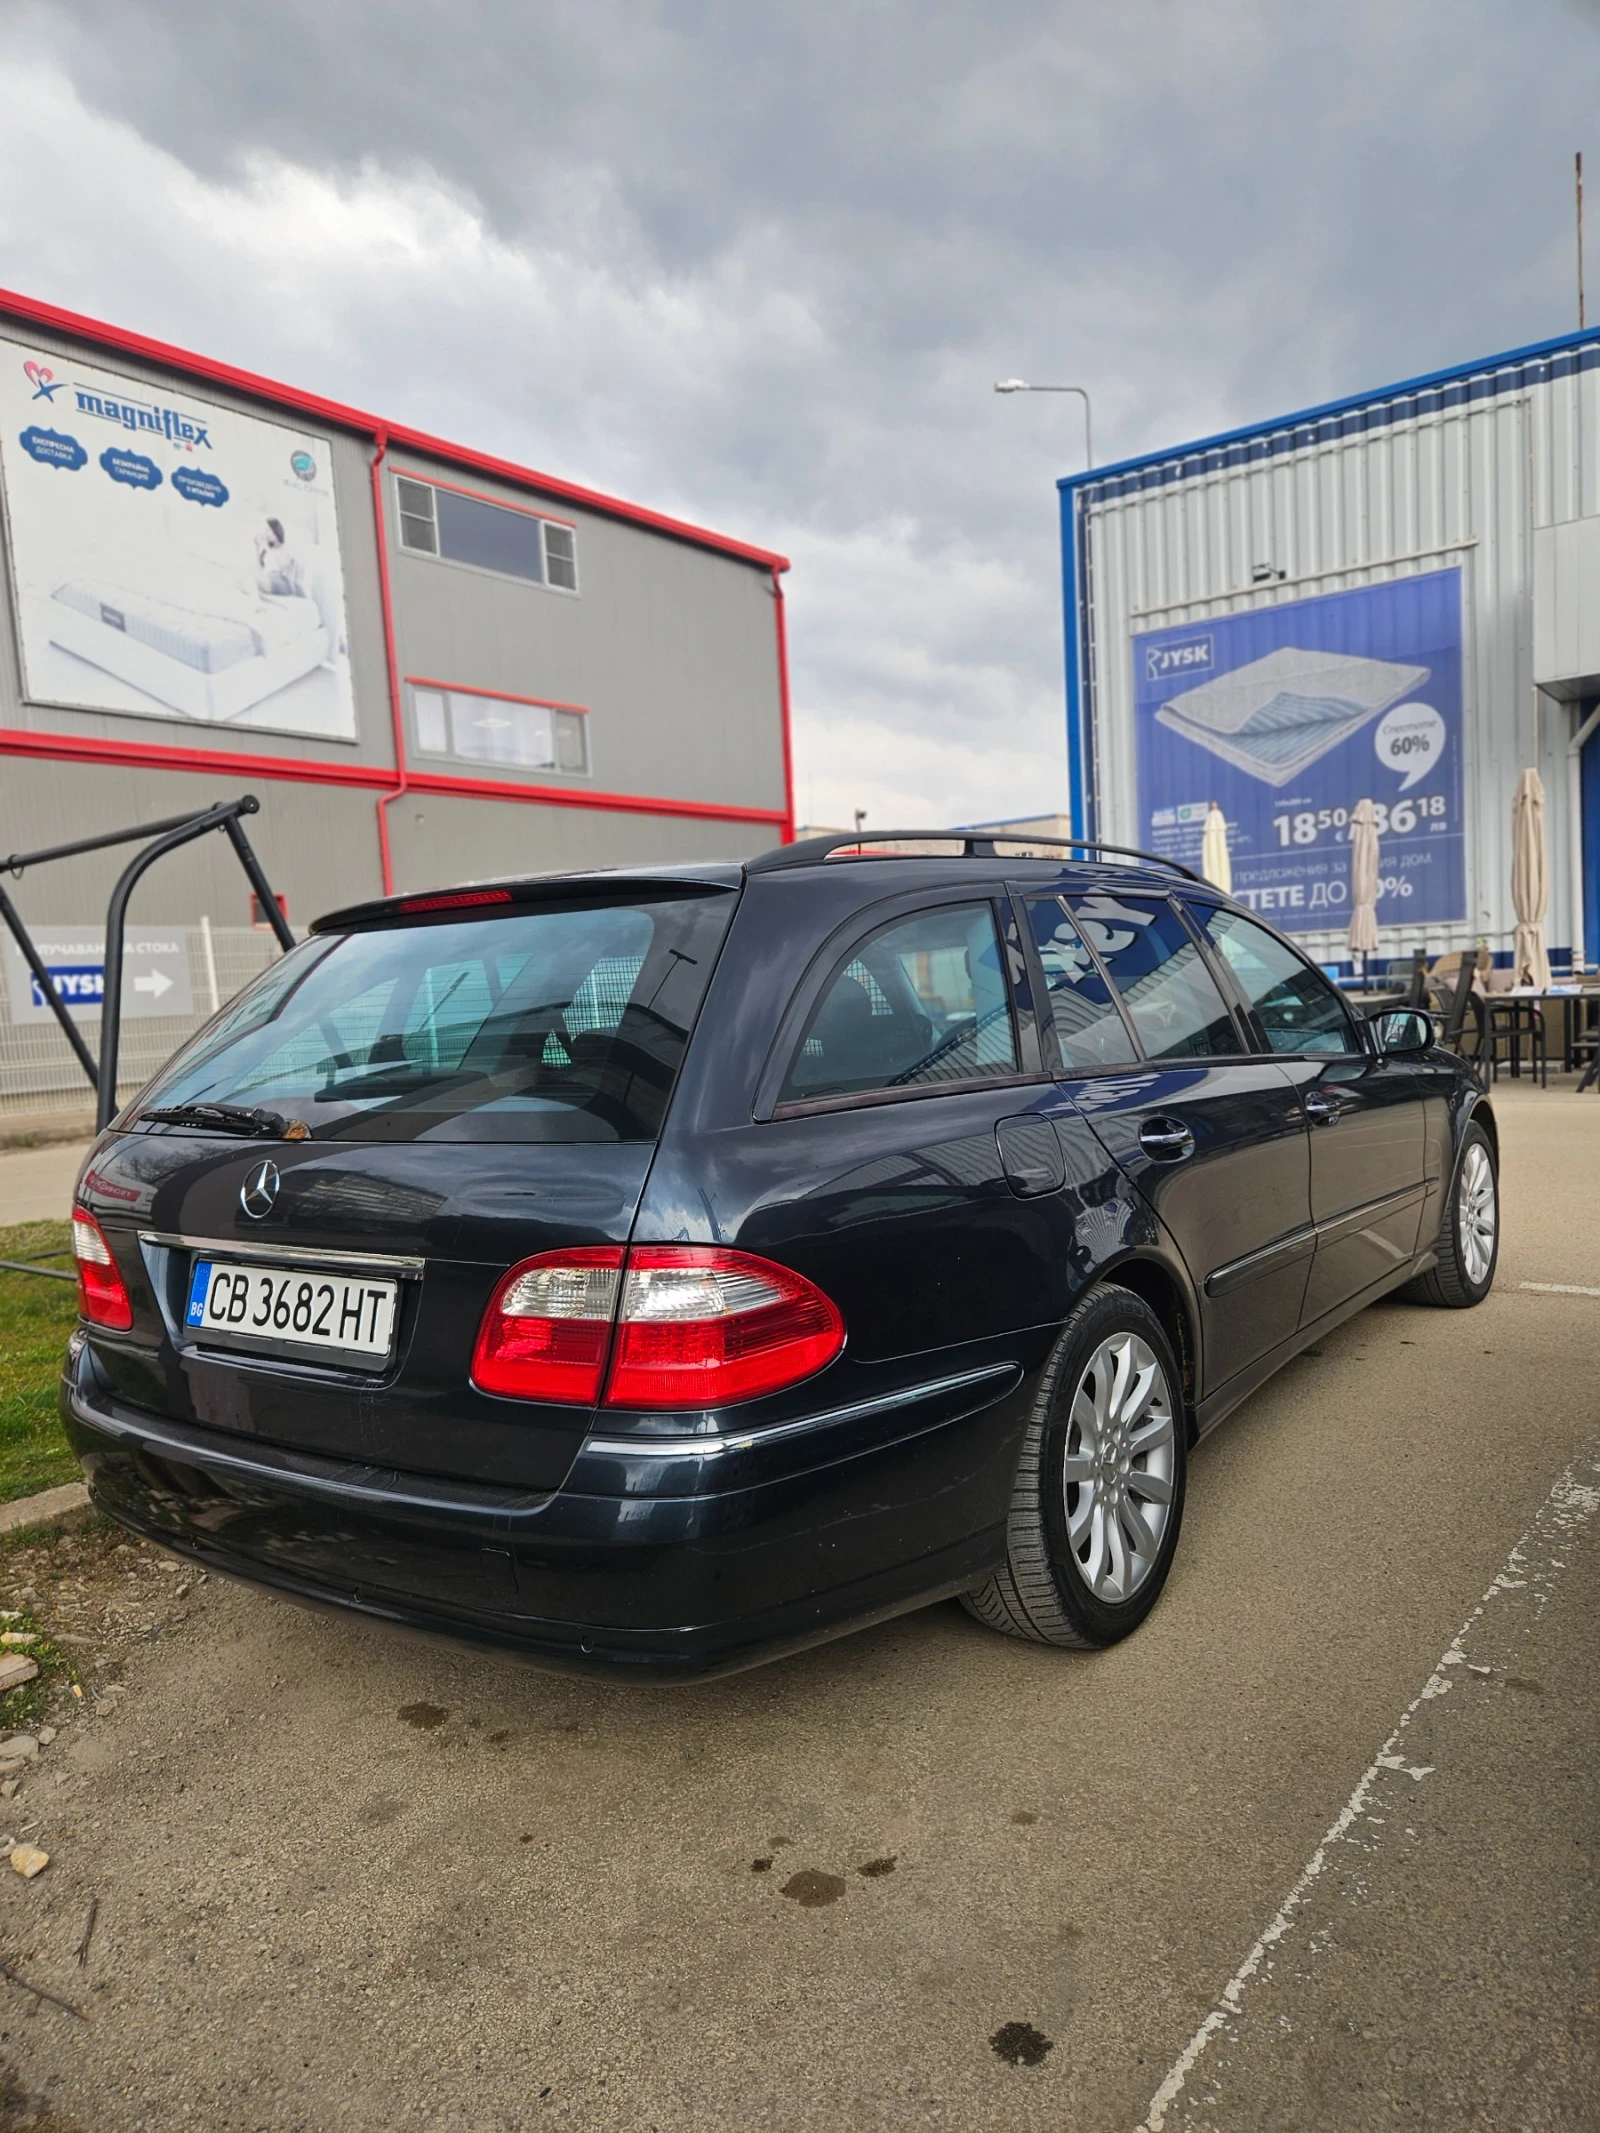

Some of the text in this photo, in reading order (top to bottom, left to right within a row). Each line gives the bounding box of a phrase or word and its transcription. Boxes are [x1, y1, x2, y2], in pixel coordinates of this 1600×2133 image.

[75, 391, 212, 450] magniflex
[1160, 643, 1209, 669] JYSK
[1390, 734, 1430, 757] 60%
[1235, 864, 1328, 884] предложения
[1332, 861, 1347, 874] за
[1309, 881, 1347, 909] ДО
[136, 941, 180, 954] СТОКА
[190, 1301, 204, 1317] BG
